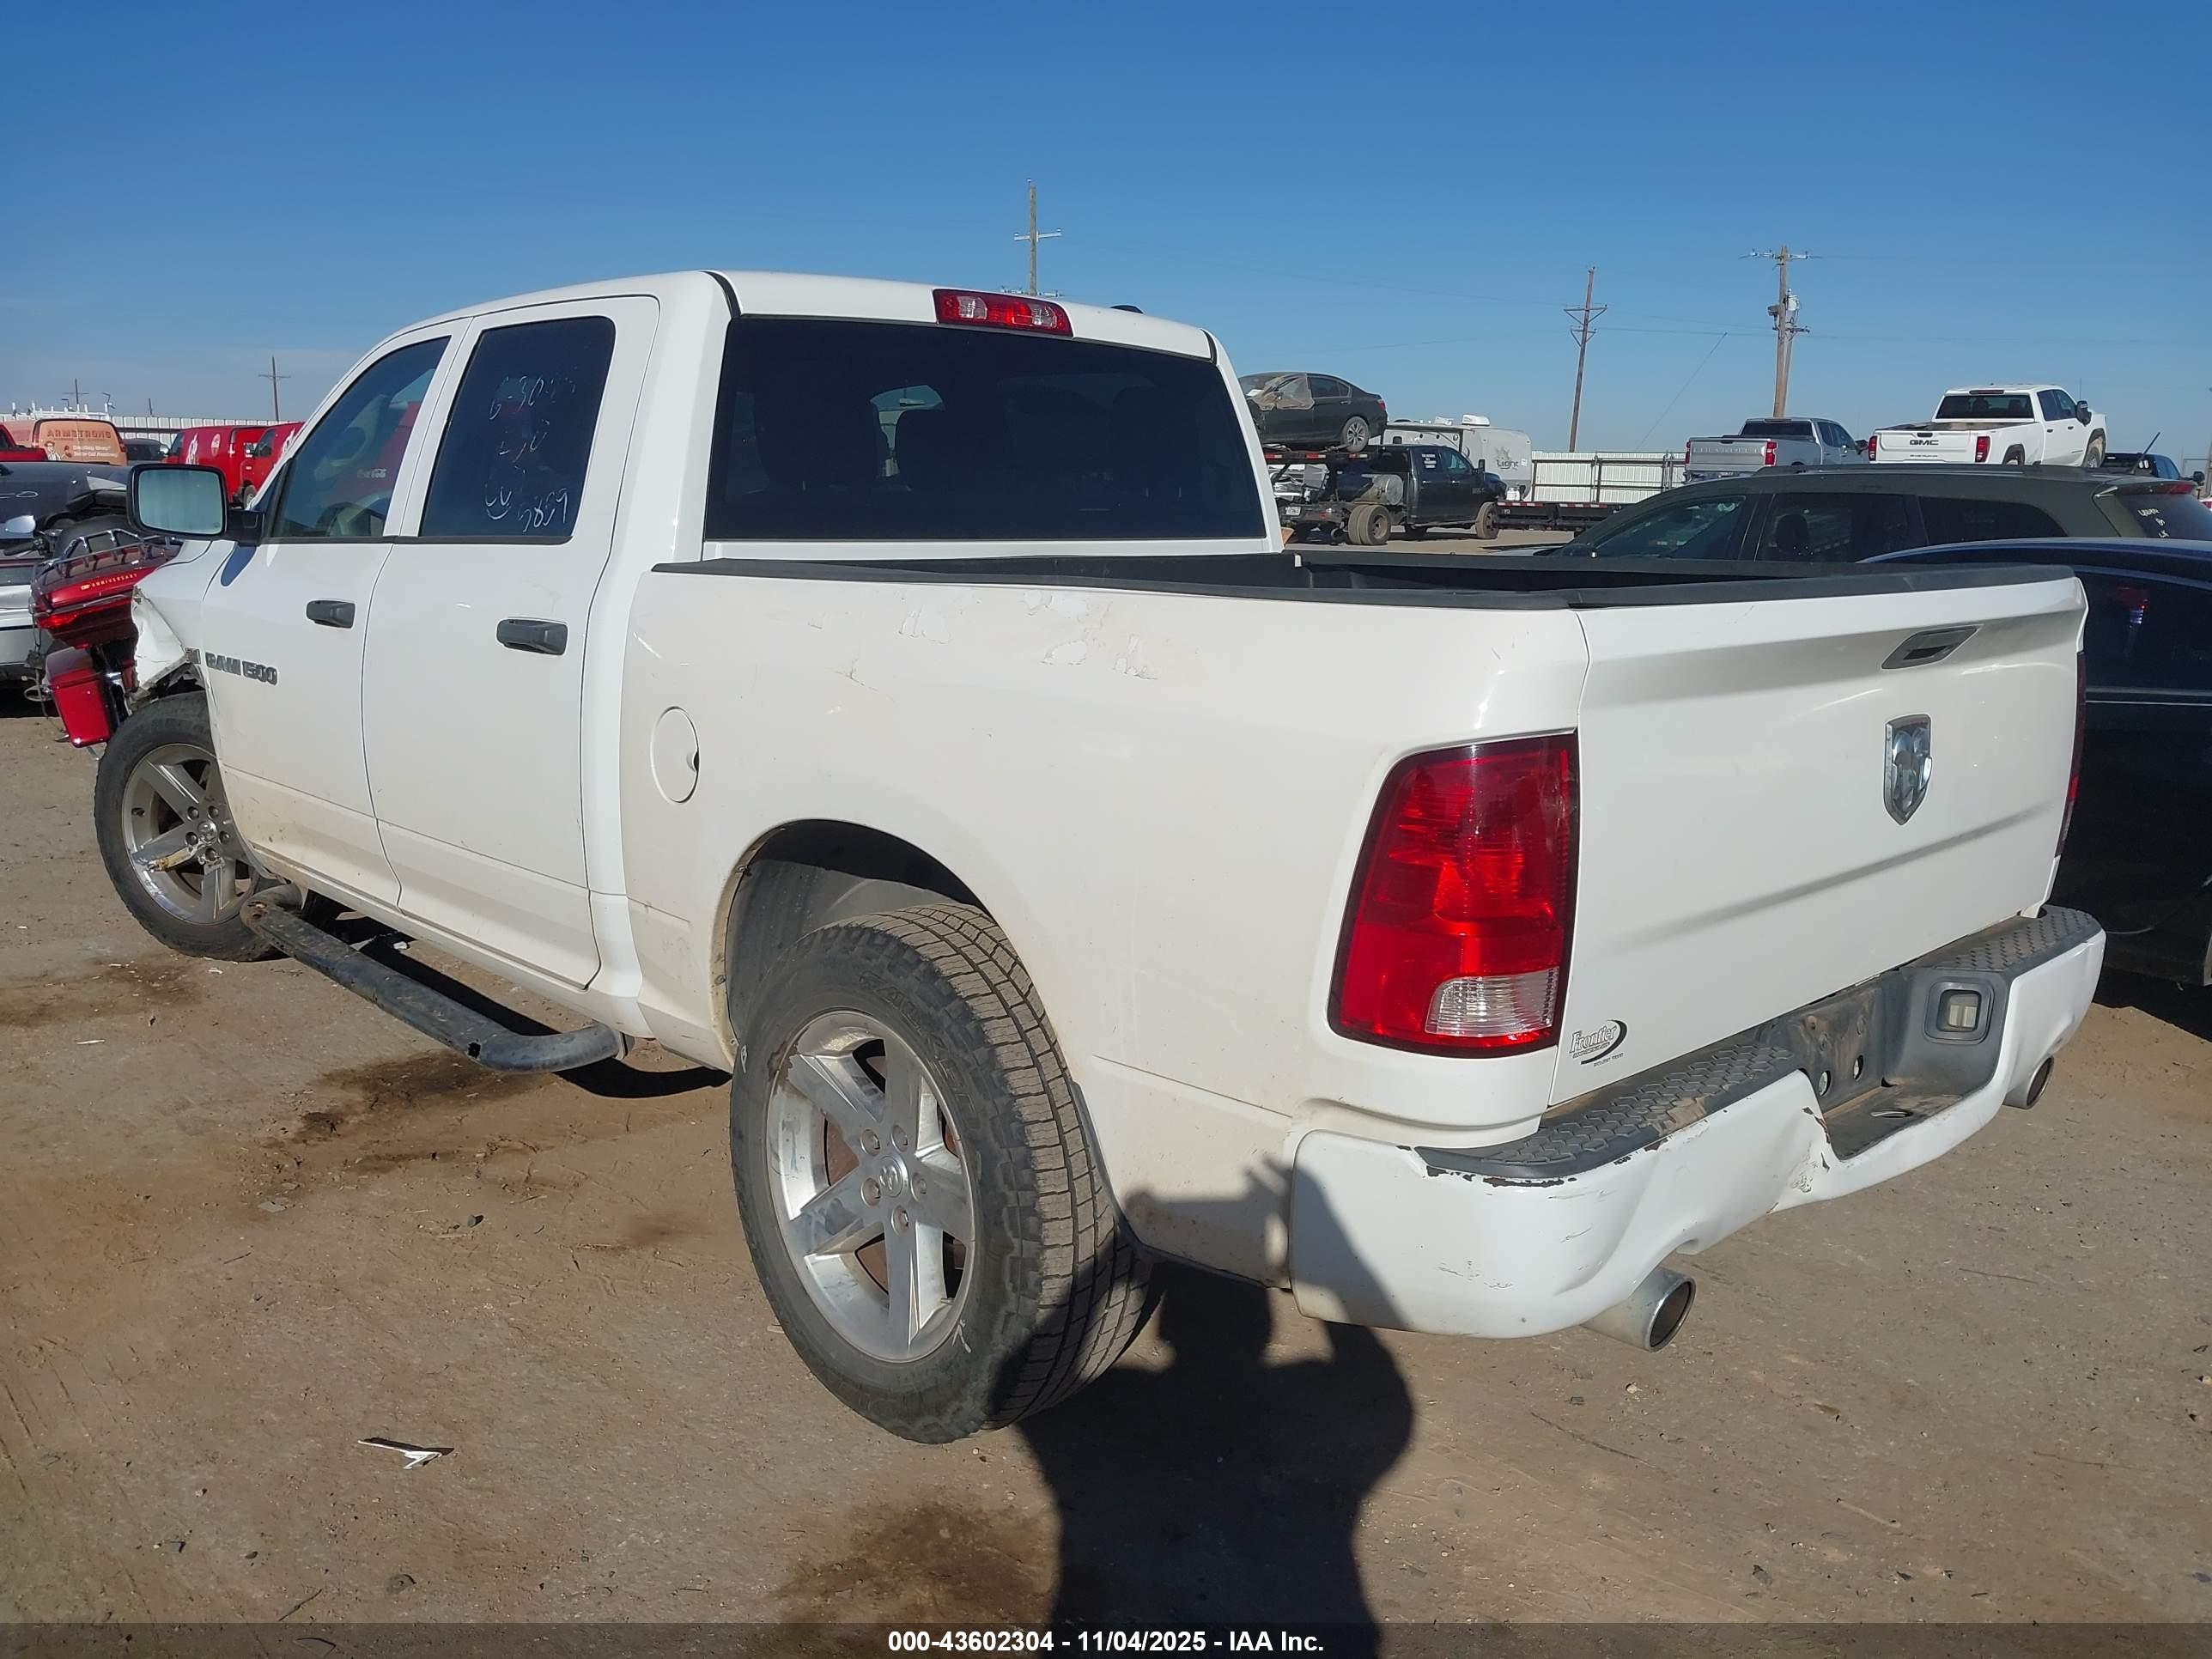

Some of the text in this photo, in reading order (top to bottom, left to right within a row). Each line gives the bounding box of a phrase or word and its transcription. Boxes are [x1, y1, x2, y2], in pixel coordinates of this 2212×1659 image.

[205, 651, 241, 676] RAM
[242, 660, 278, 686] 1500
[1569, 1025, 1618, 1054] Frontier
